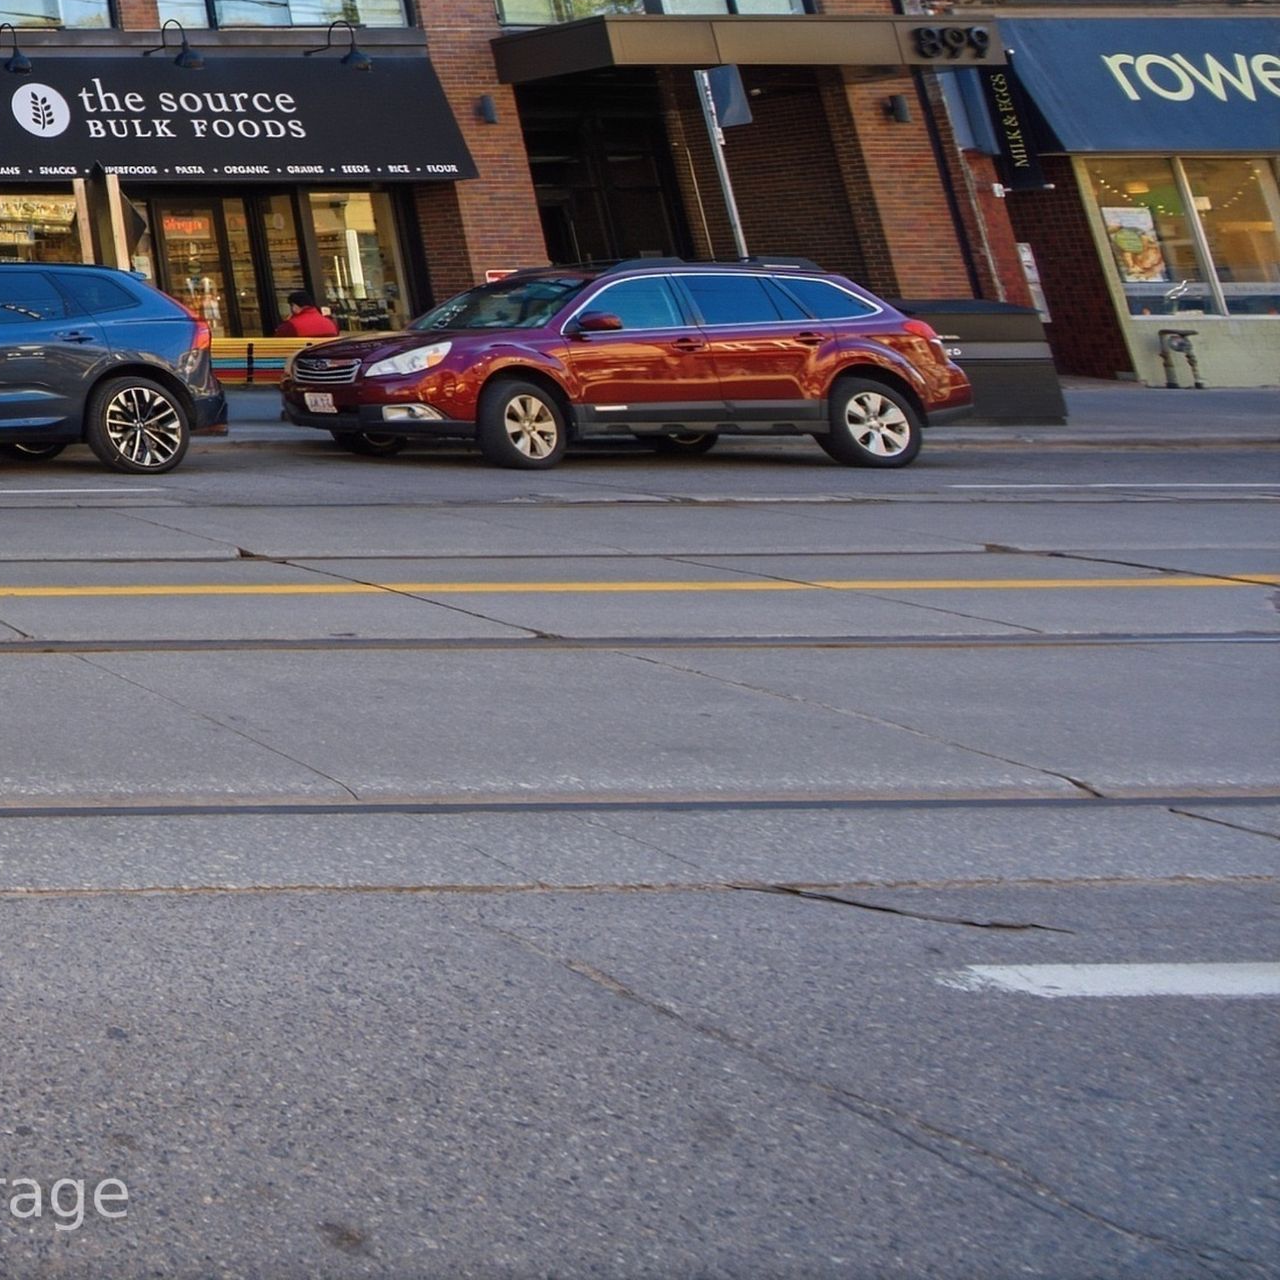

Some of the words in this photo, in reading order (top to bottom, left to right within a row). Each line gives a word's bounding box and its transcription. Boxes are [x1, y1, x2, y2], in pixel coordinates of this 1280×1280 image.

[911, 26, 989, 59] 899
[990, 73, 1014, 112] EGGS
[1100, 52, 1280, 102] rowe
[77, 77, 146, 113] the
[158, 91, 298, 113] source
[86, 119, 177, 138] BULK
[187, 119, 307, 138] FOODS
[1002, 115, 1019, 127] &
[1006, 130, 1030, 168] MILK
[39, 166, 78, 175] SNACKS
[175, 165, 205, 175] PASTA
[224, 165, 270, 174] ORGANIC
[341, 165, 371, 174] SEEDS
[388, 164, 411, 173] RICE
[426, 164, 459, 173] FLOUR
